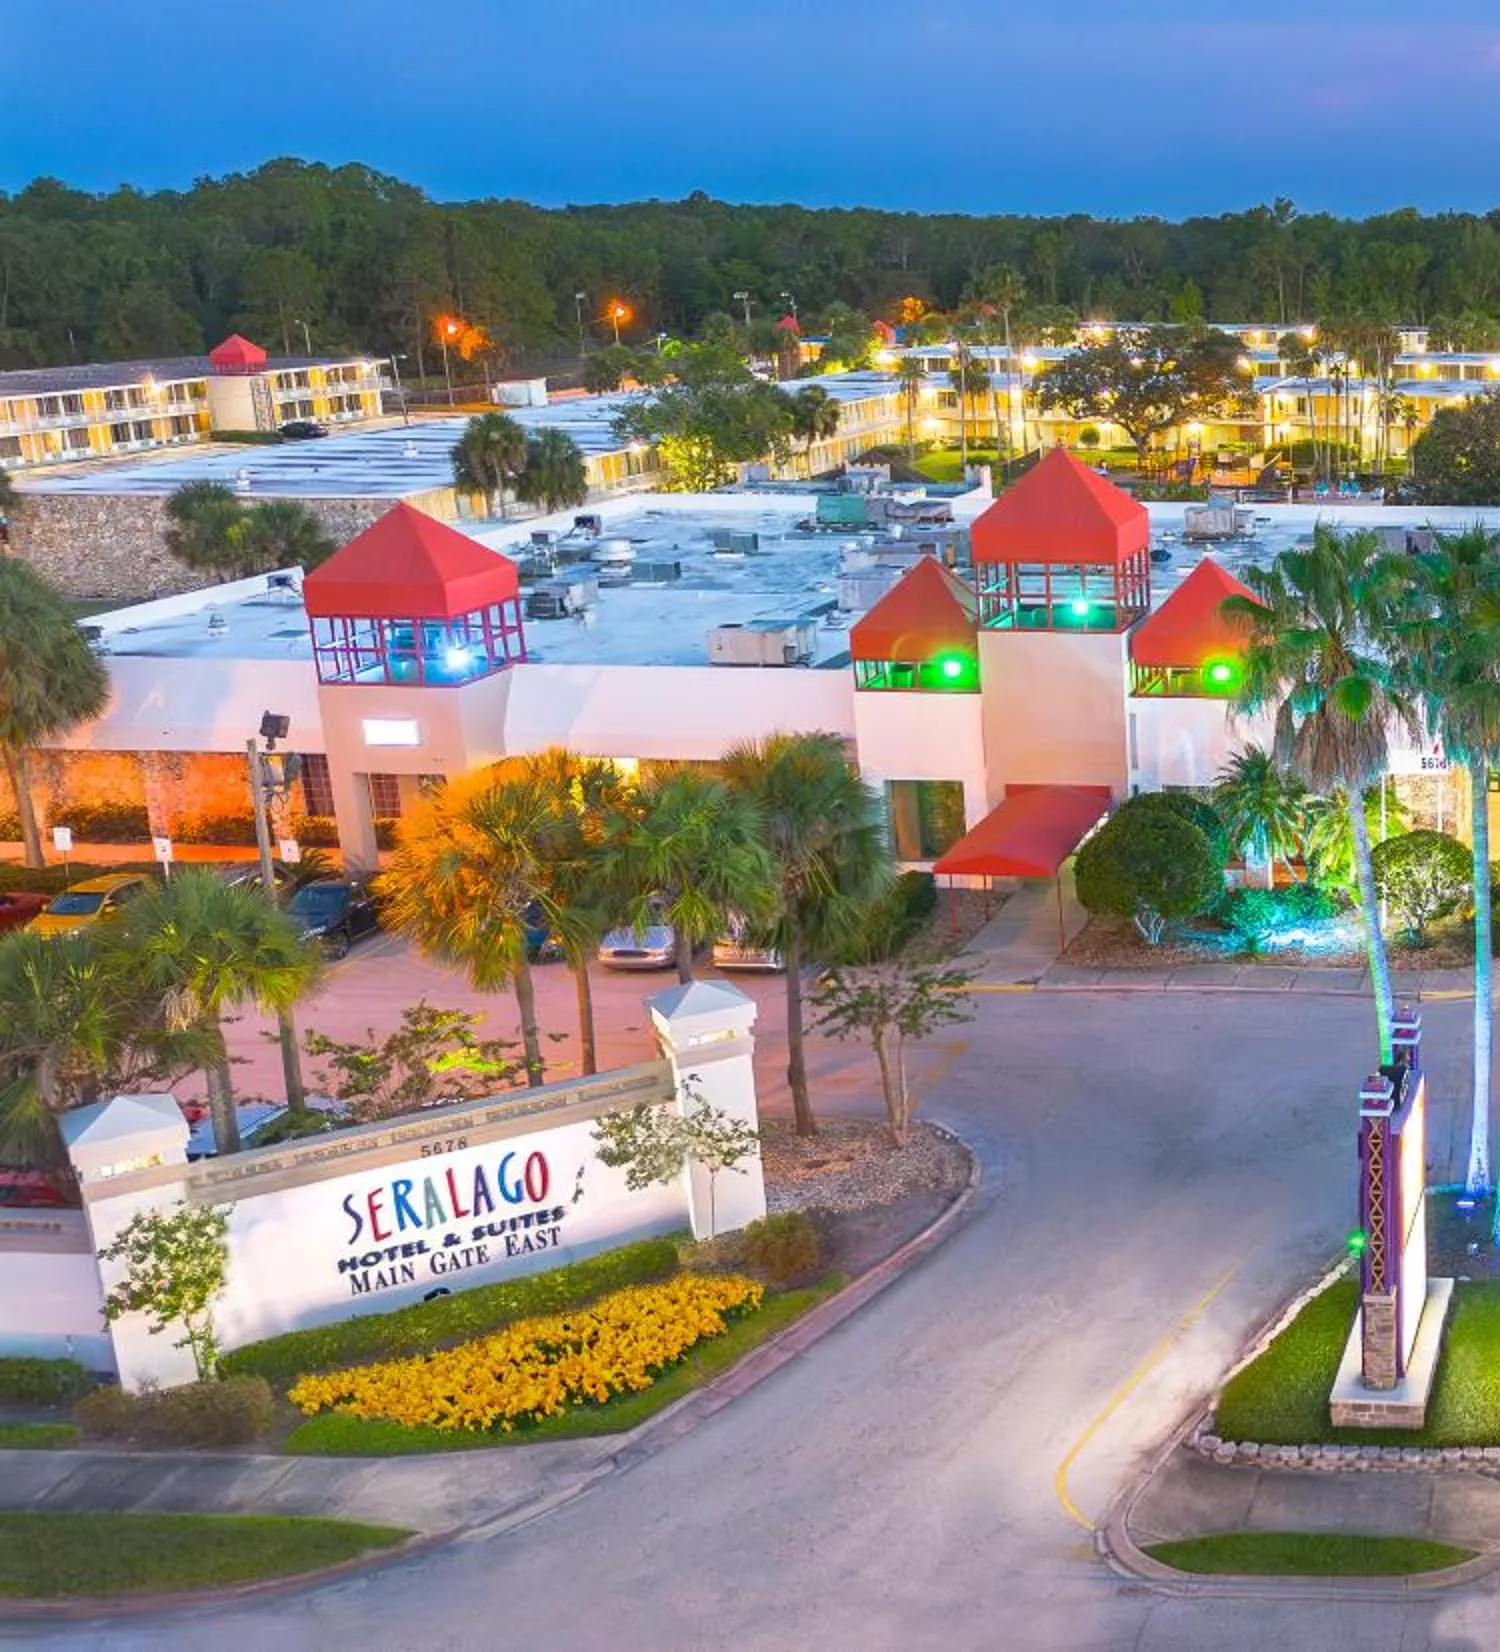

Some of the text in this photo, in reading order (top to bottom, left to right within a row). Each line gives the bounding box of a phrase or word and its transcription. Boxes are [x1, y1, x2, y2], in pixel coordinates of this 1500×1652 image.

[342, 1150, 550, 1246] SERALAGO
[337, 1205, 565, 1274] HOTEL & SUITES
[350, 1225, 562, 1296] MAIN GATE EAST
